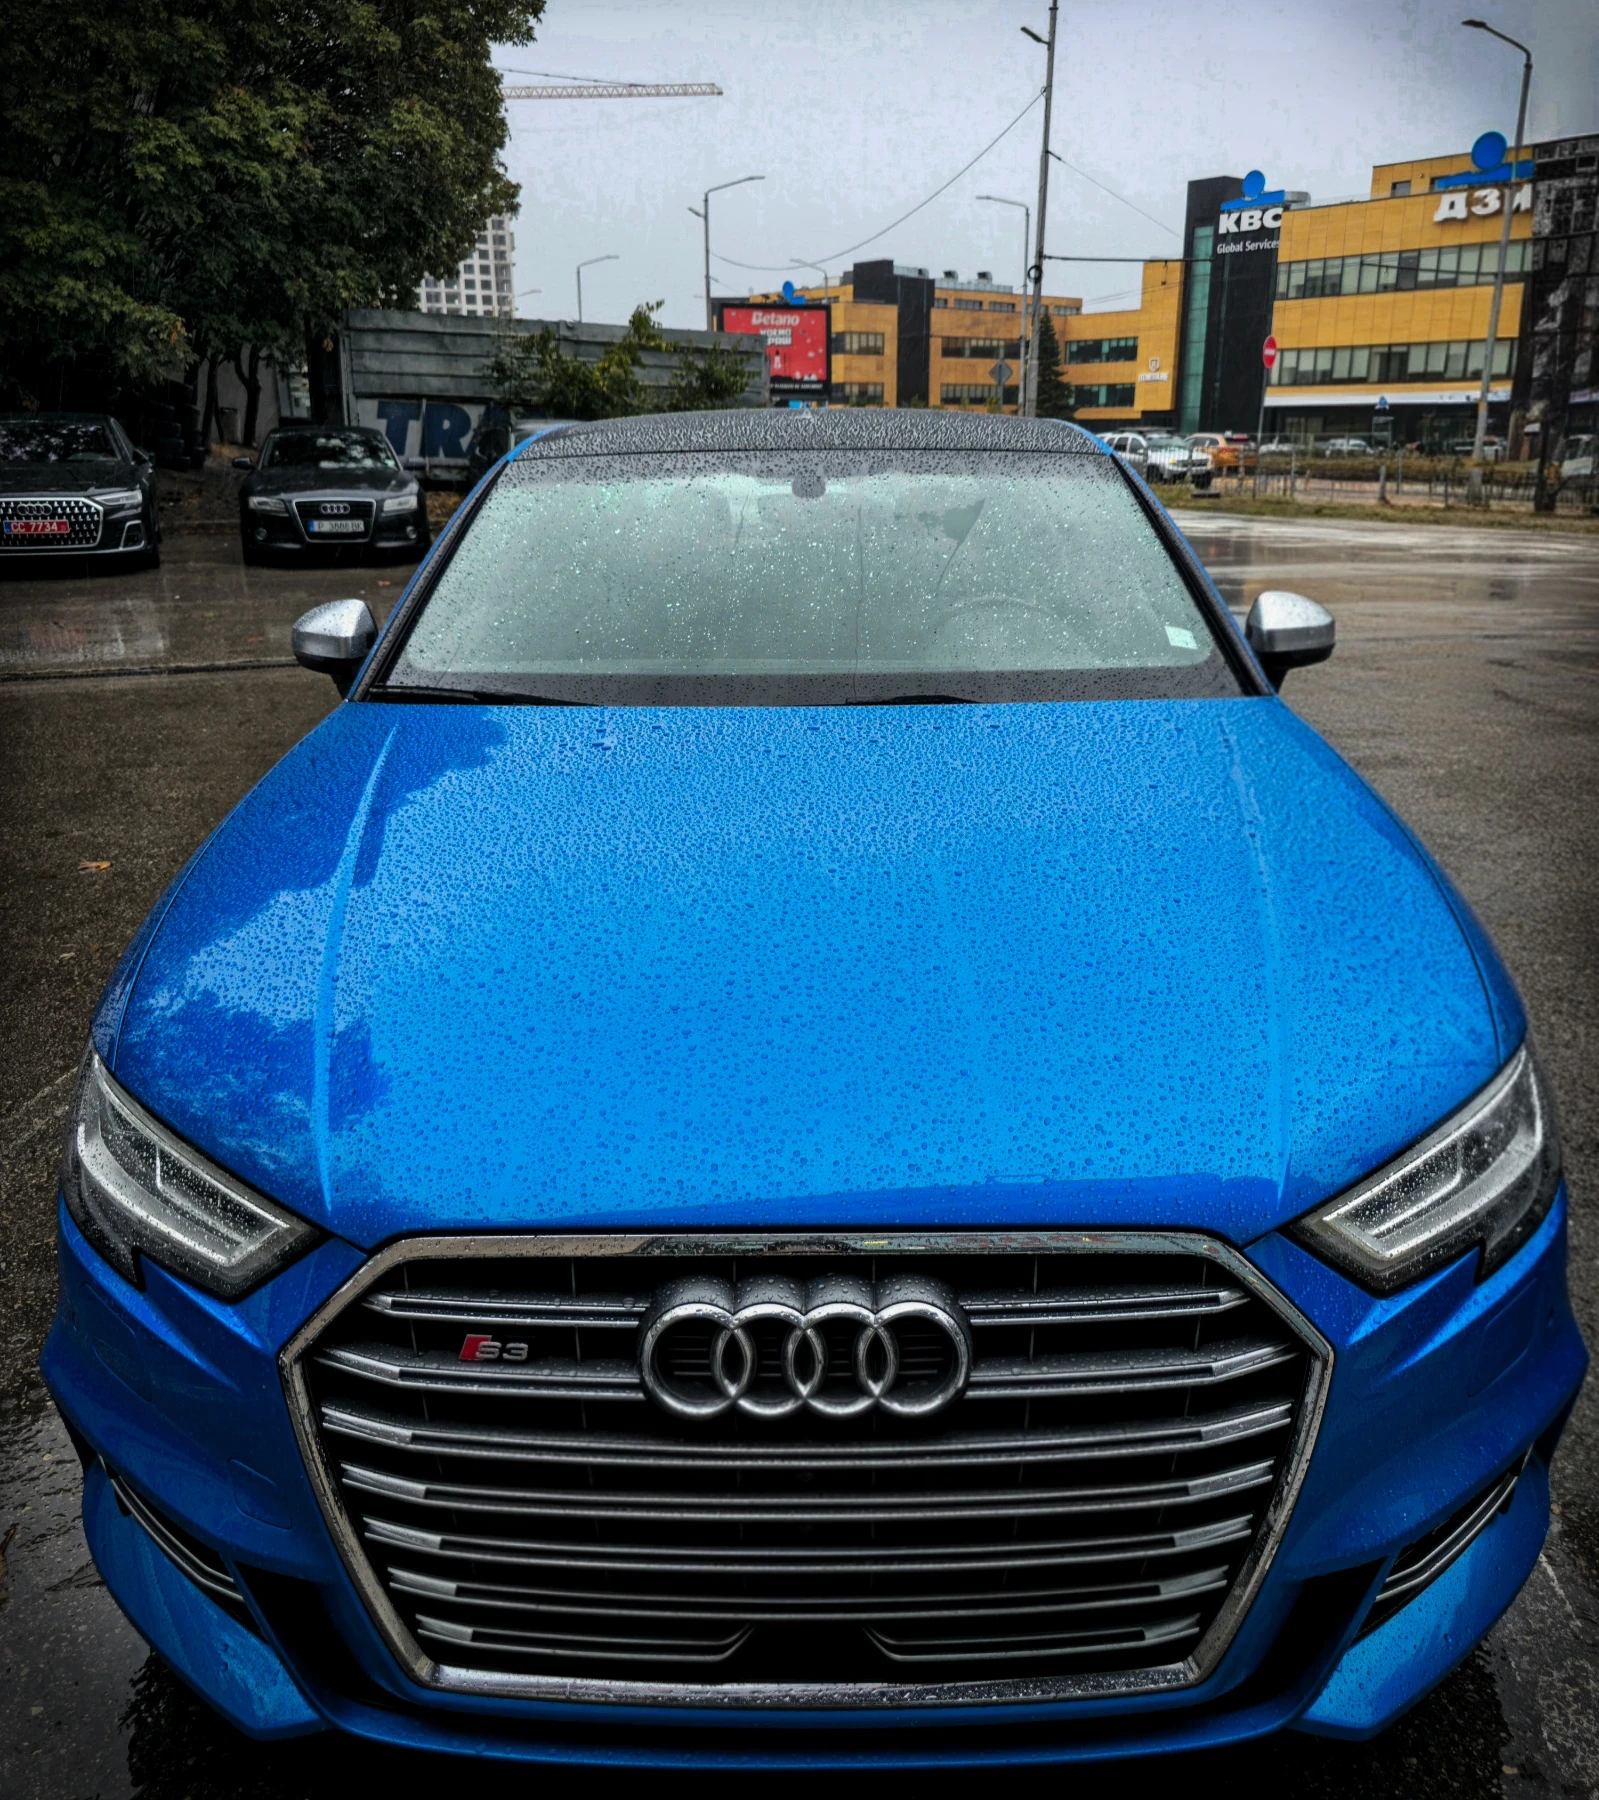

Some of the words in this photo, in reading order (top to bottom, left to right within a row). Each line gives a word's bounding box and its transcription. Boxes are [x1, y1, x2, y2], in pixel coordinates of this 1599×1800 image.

[1218, 207, 1284, 234] KBC
[1216, 241, 1243, 254] Global
[751, 311, 800, 326] Betano
[29, 522, 58, 532] 7734
[475, 1341, 529, 1360] S3
